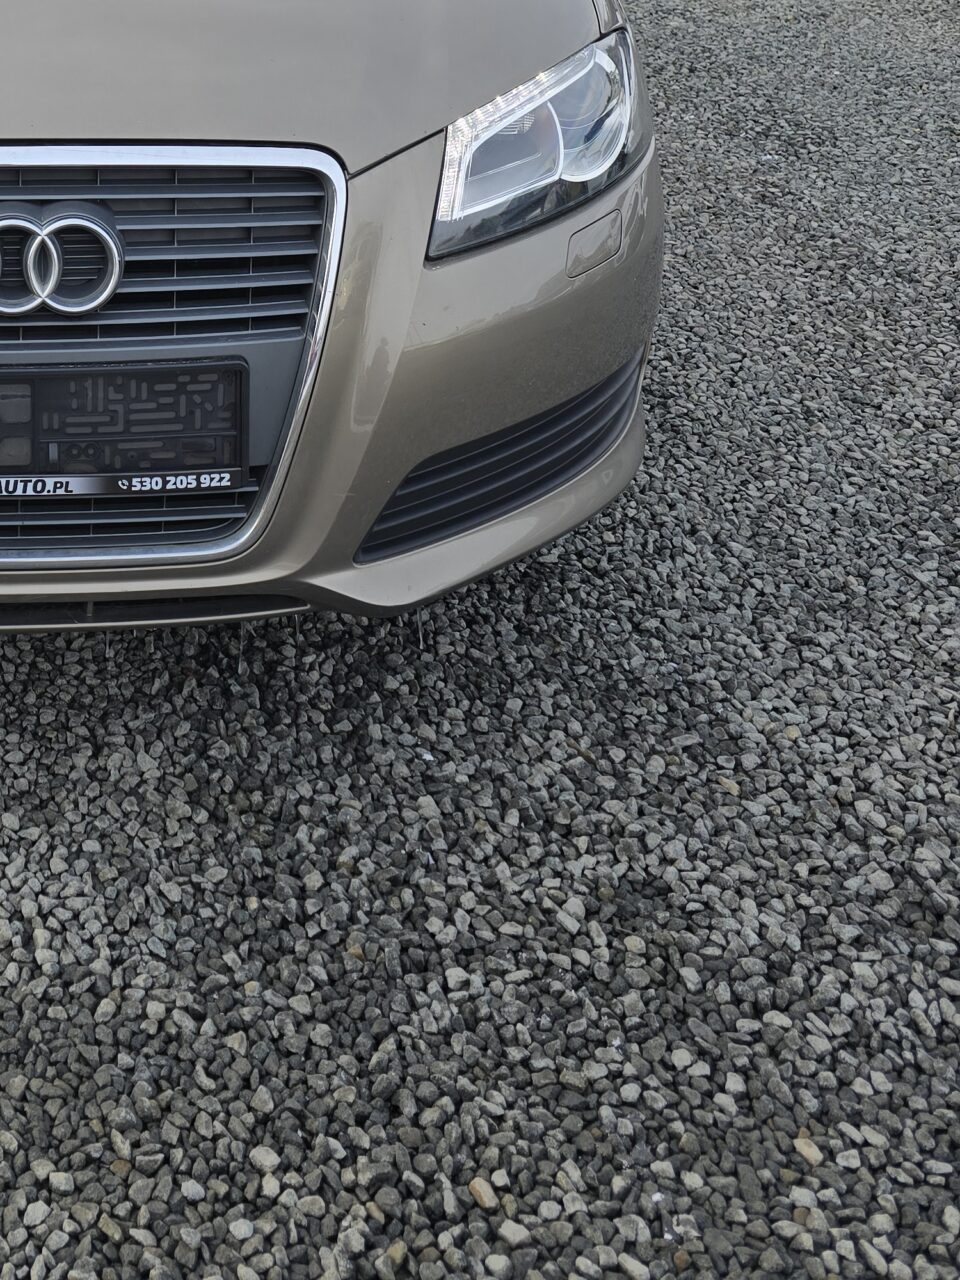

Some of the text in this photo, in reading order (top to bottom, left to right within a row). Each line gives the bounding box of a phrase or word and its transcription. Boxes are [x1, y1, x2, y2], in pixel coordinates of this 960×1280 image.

[131, 473, 231, 491] 530 205 922
